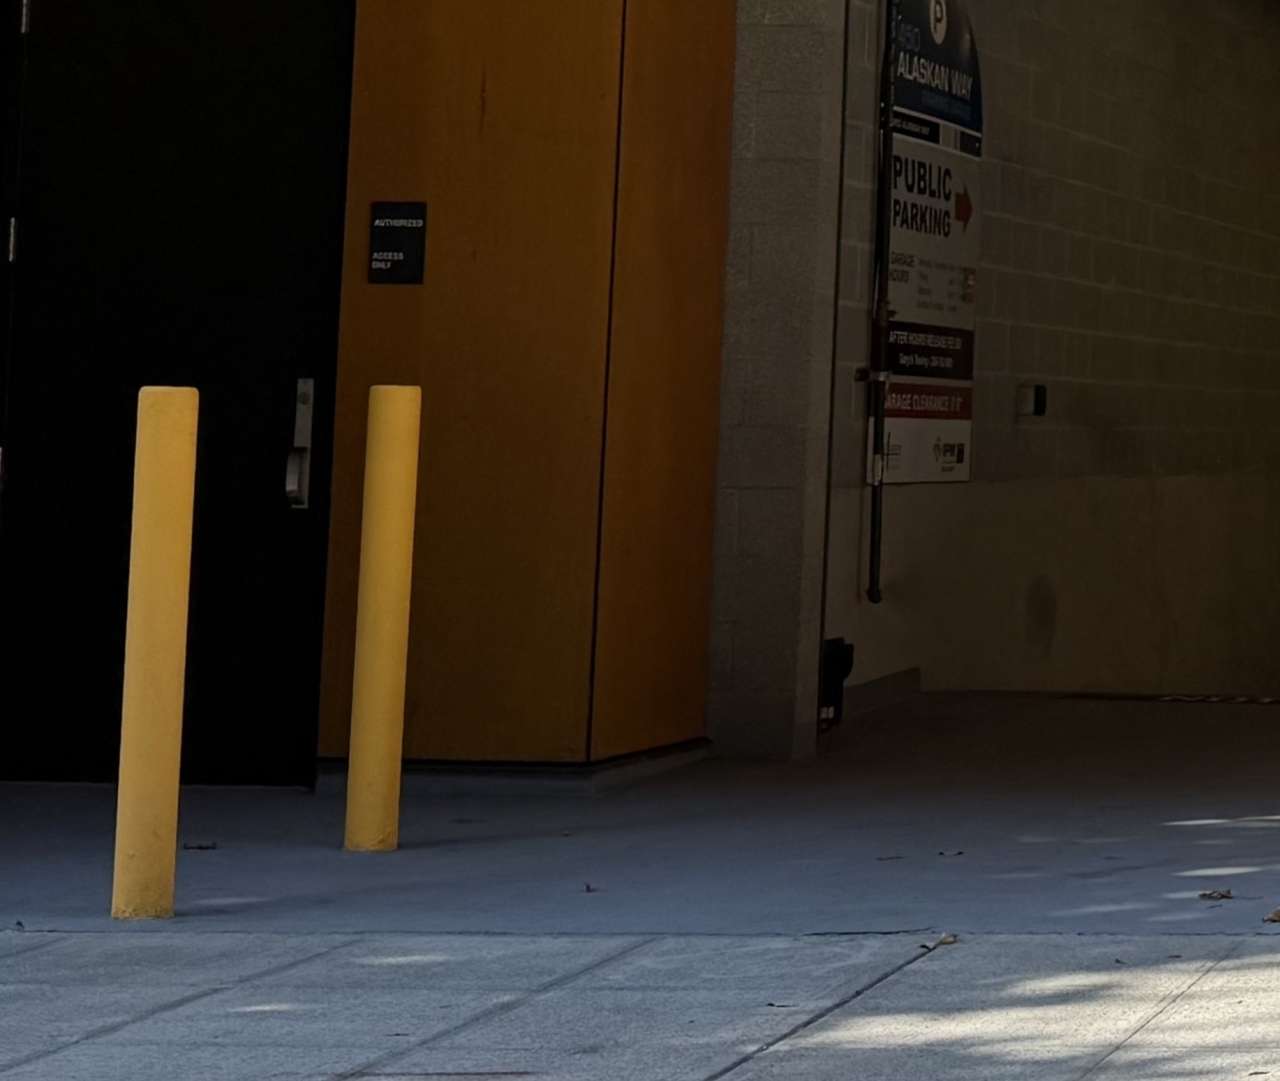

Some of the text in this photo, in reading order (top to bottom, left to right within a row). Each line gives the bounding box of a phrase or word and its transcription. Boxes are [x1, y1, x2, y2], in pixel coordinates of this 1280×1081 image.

[897, 51, 973, 101] ALASKAN WAY
[893, 155, 952, 202] PUBLIC
[893, 198, 951, 238] PARKING
[372, 252, 404, 260] ACCESS
